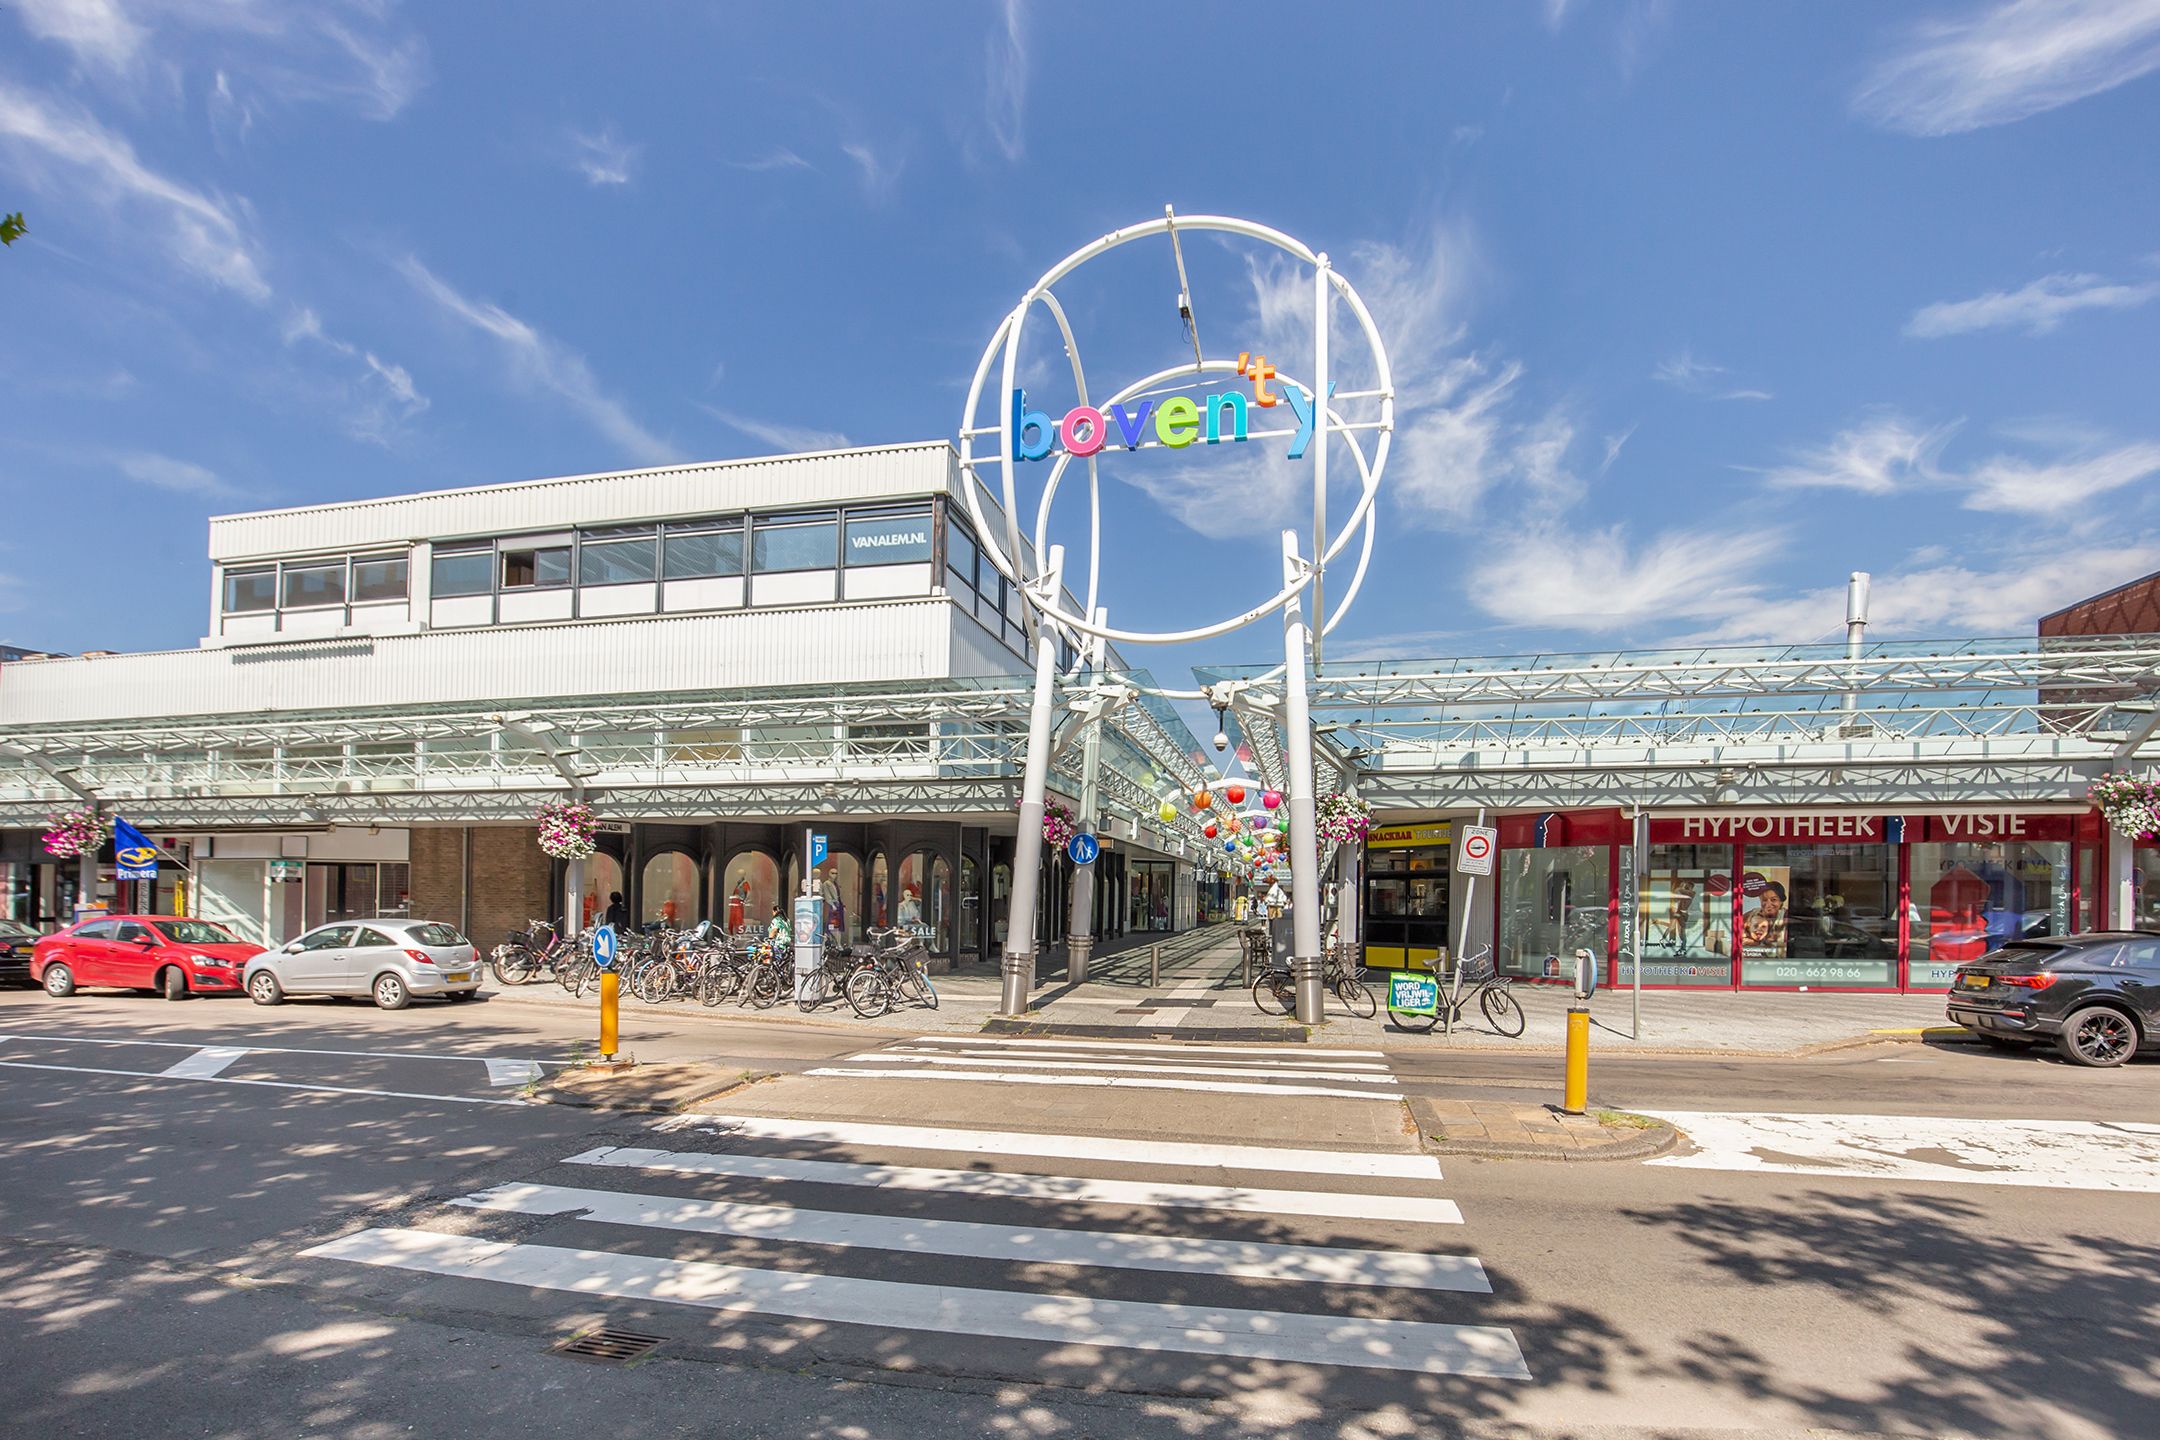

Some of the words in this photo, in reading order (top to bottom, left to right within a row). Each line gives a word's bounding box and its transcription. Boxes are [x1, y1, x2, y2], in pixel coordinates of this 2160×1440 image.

[1013, 388, 1248, 462] boven
[852, 532, 927, 548] VANALEM.NL
[1683, 815, 1875, 837] HYPOTHEEK
[1939, 814, 2026, 835] VISIE
[1368, 831, 1412, 842] SNACKBAR
[815, 844, 823, 857] P
[738, 925, 764, 934] SALE
[911, 927, 937, 936] SALE
[1698, 966, 1727, 977] VISIE
[1776, 967, 1797, 977] 020
[1806, 967, 1827, 978] 662
[1829, 967, 1844, 978] 98
[1846, 968, 1861, 978] 66
[1395, 982, 1420, 991] WORD
[1397, 998, 1421, 1007] LIGER
